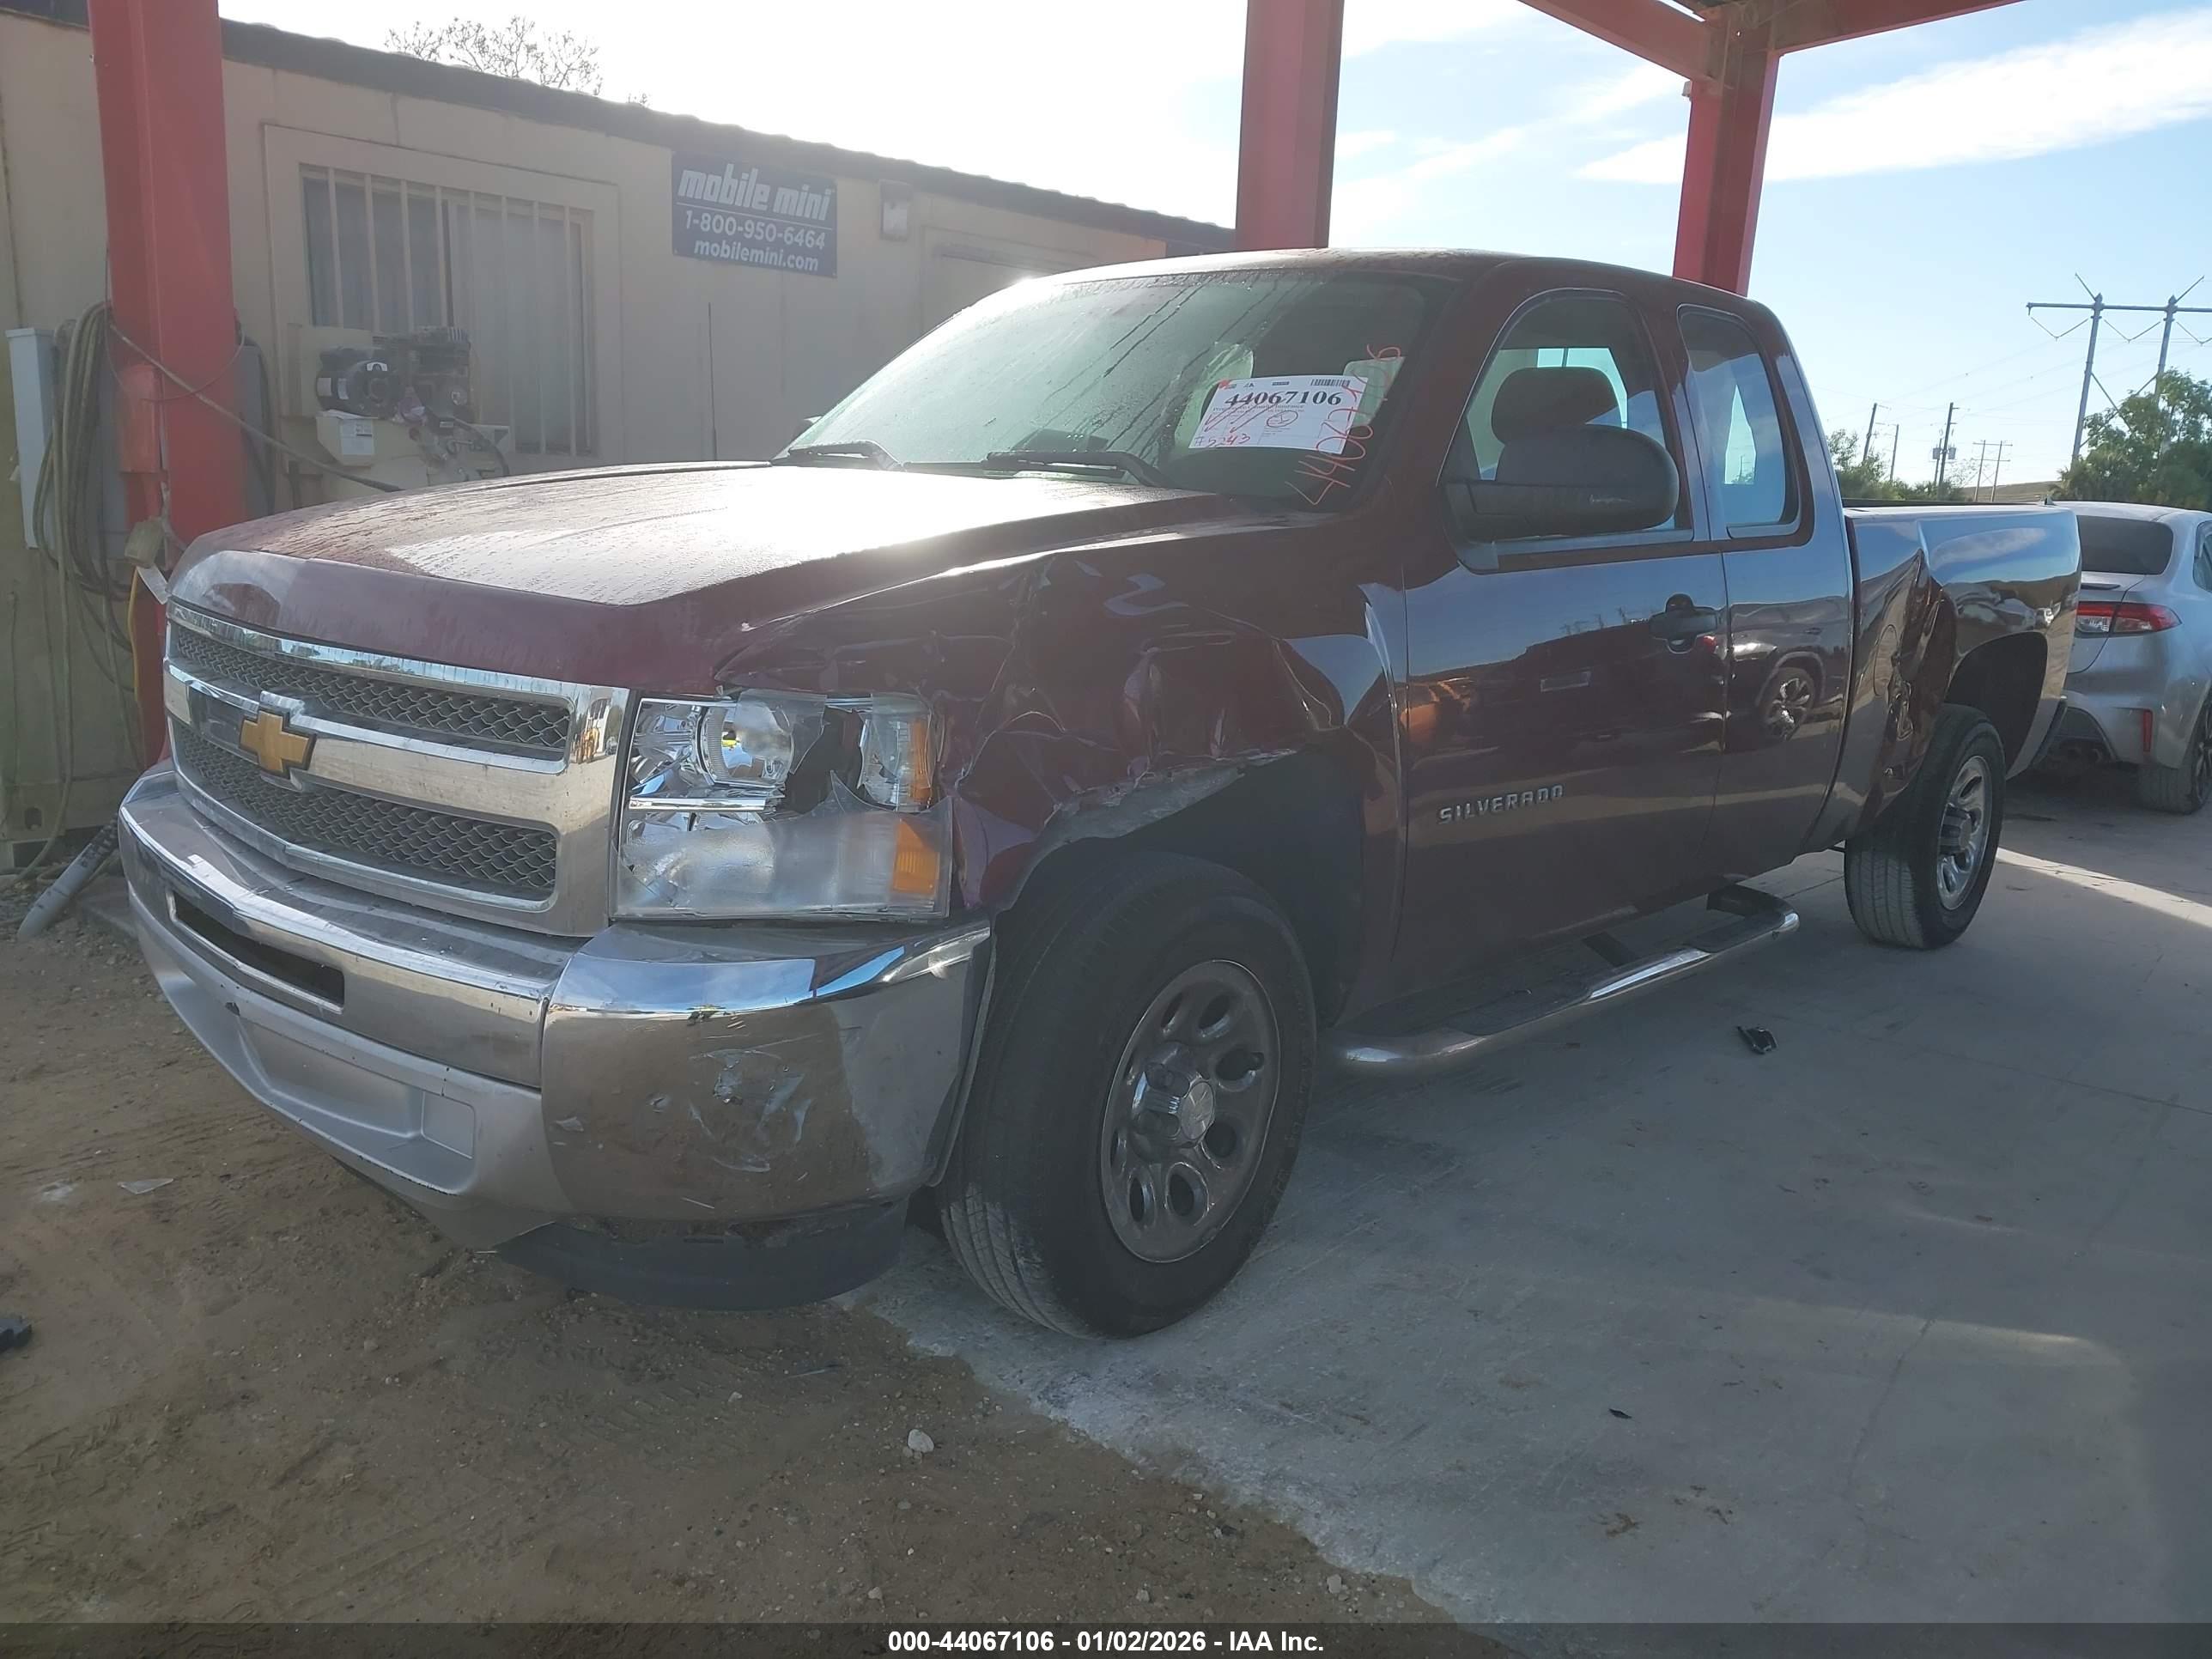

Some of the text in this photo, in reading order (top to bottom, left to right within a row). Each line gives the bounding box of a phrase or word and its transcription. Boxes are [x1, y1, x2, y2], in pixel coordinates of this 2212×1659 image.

[678, 163, 832, 221] mobile mini
[685, 210, 825, 250] 1-800-950-6464
[694, 240, 818, 271] mobilemini.com
[1224, 391, 1344, 406] 44067106
[1438, 784, 1565, 825] SILVERADO
